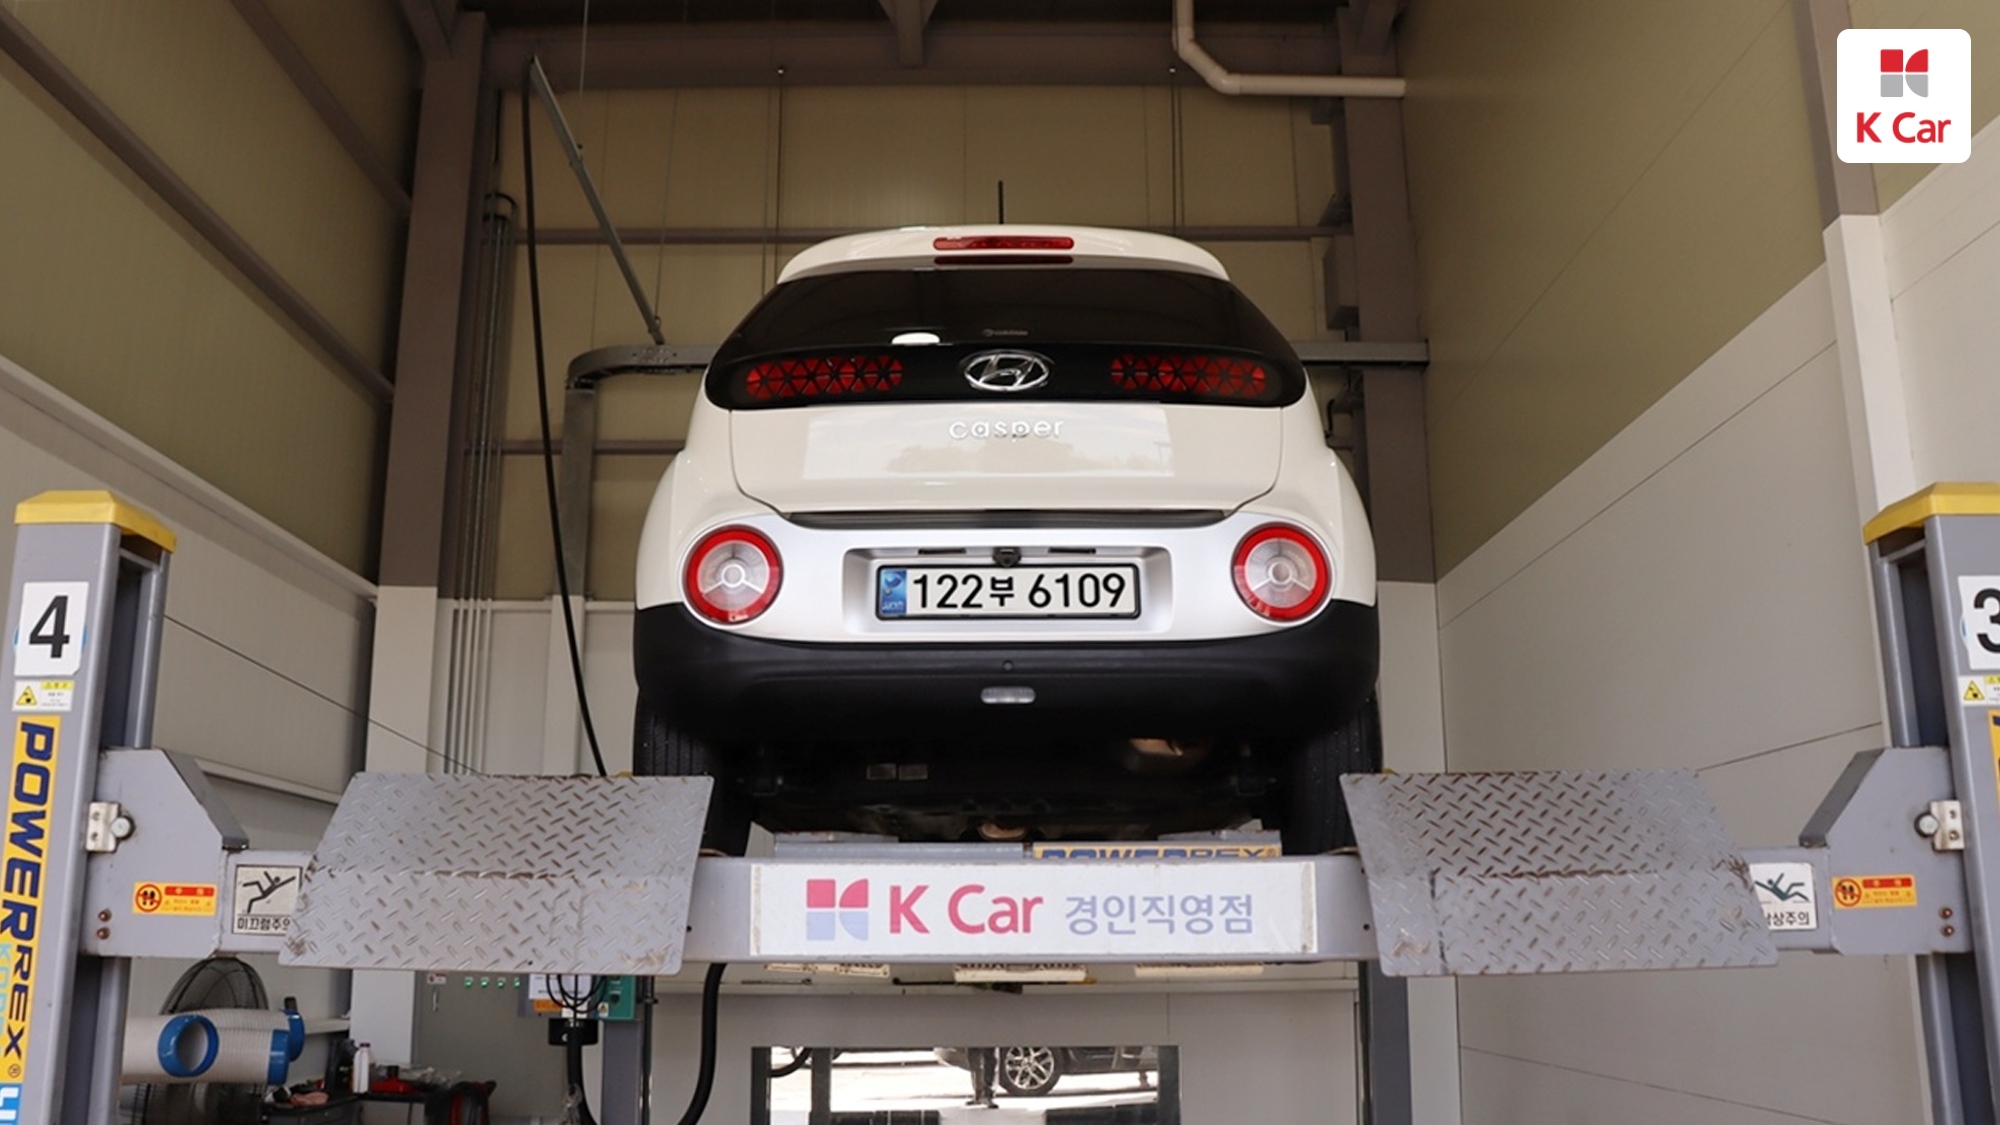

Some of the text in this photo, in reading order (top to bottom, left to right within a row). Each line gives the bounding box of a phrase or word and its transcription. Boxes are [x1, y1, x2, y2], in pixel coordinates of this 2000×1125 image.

[949, 420, 1064, 442] casper
[913, 573, 1126, 609] 122부 6109
[29, 595, 70, 658] 4
[1973, 588, 2000, 653] 3
[889, 884, 1254, 936] K Car 경인직영점
[1766, 911, 1810, 926] 상주의
